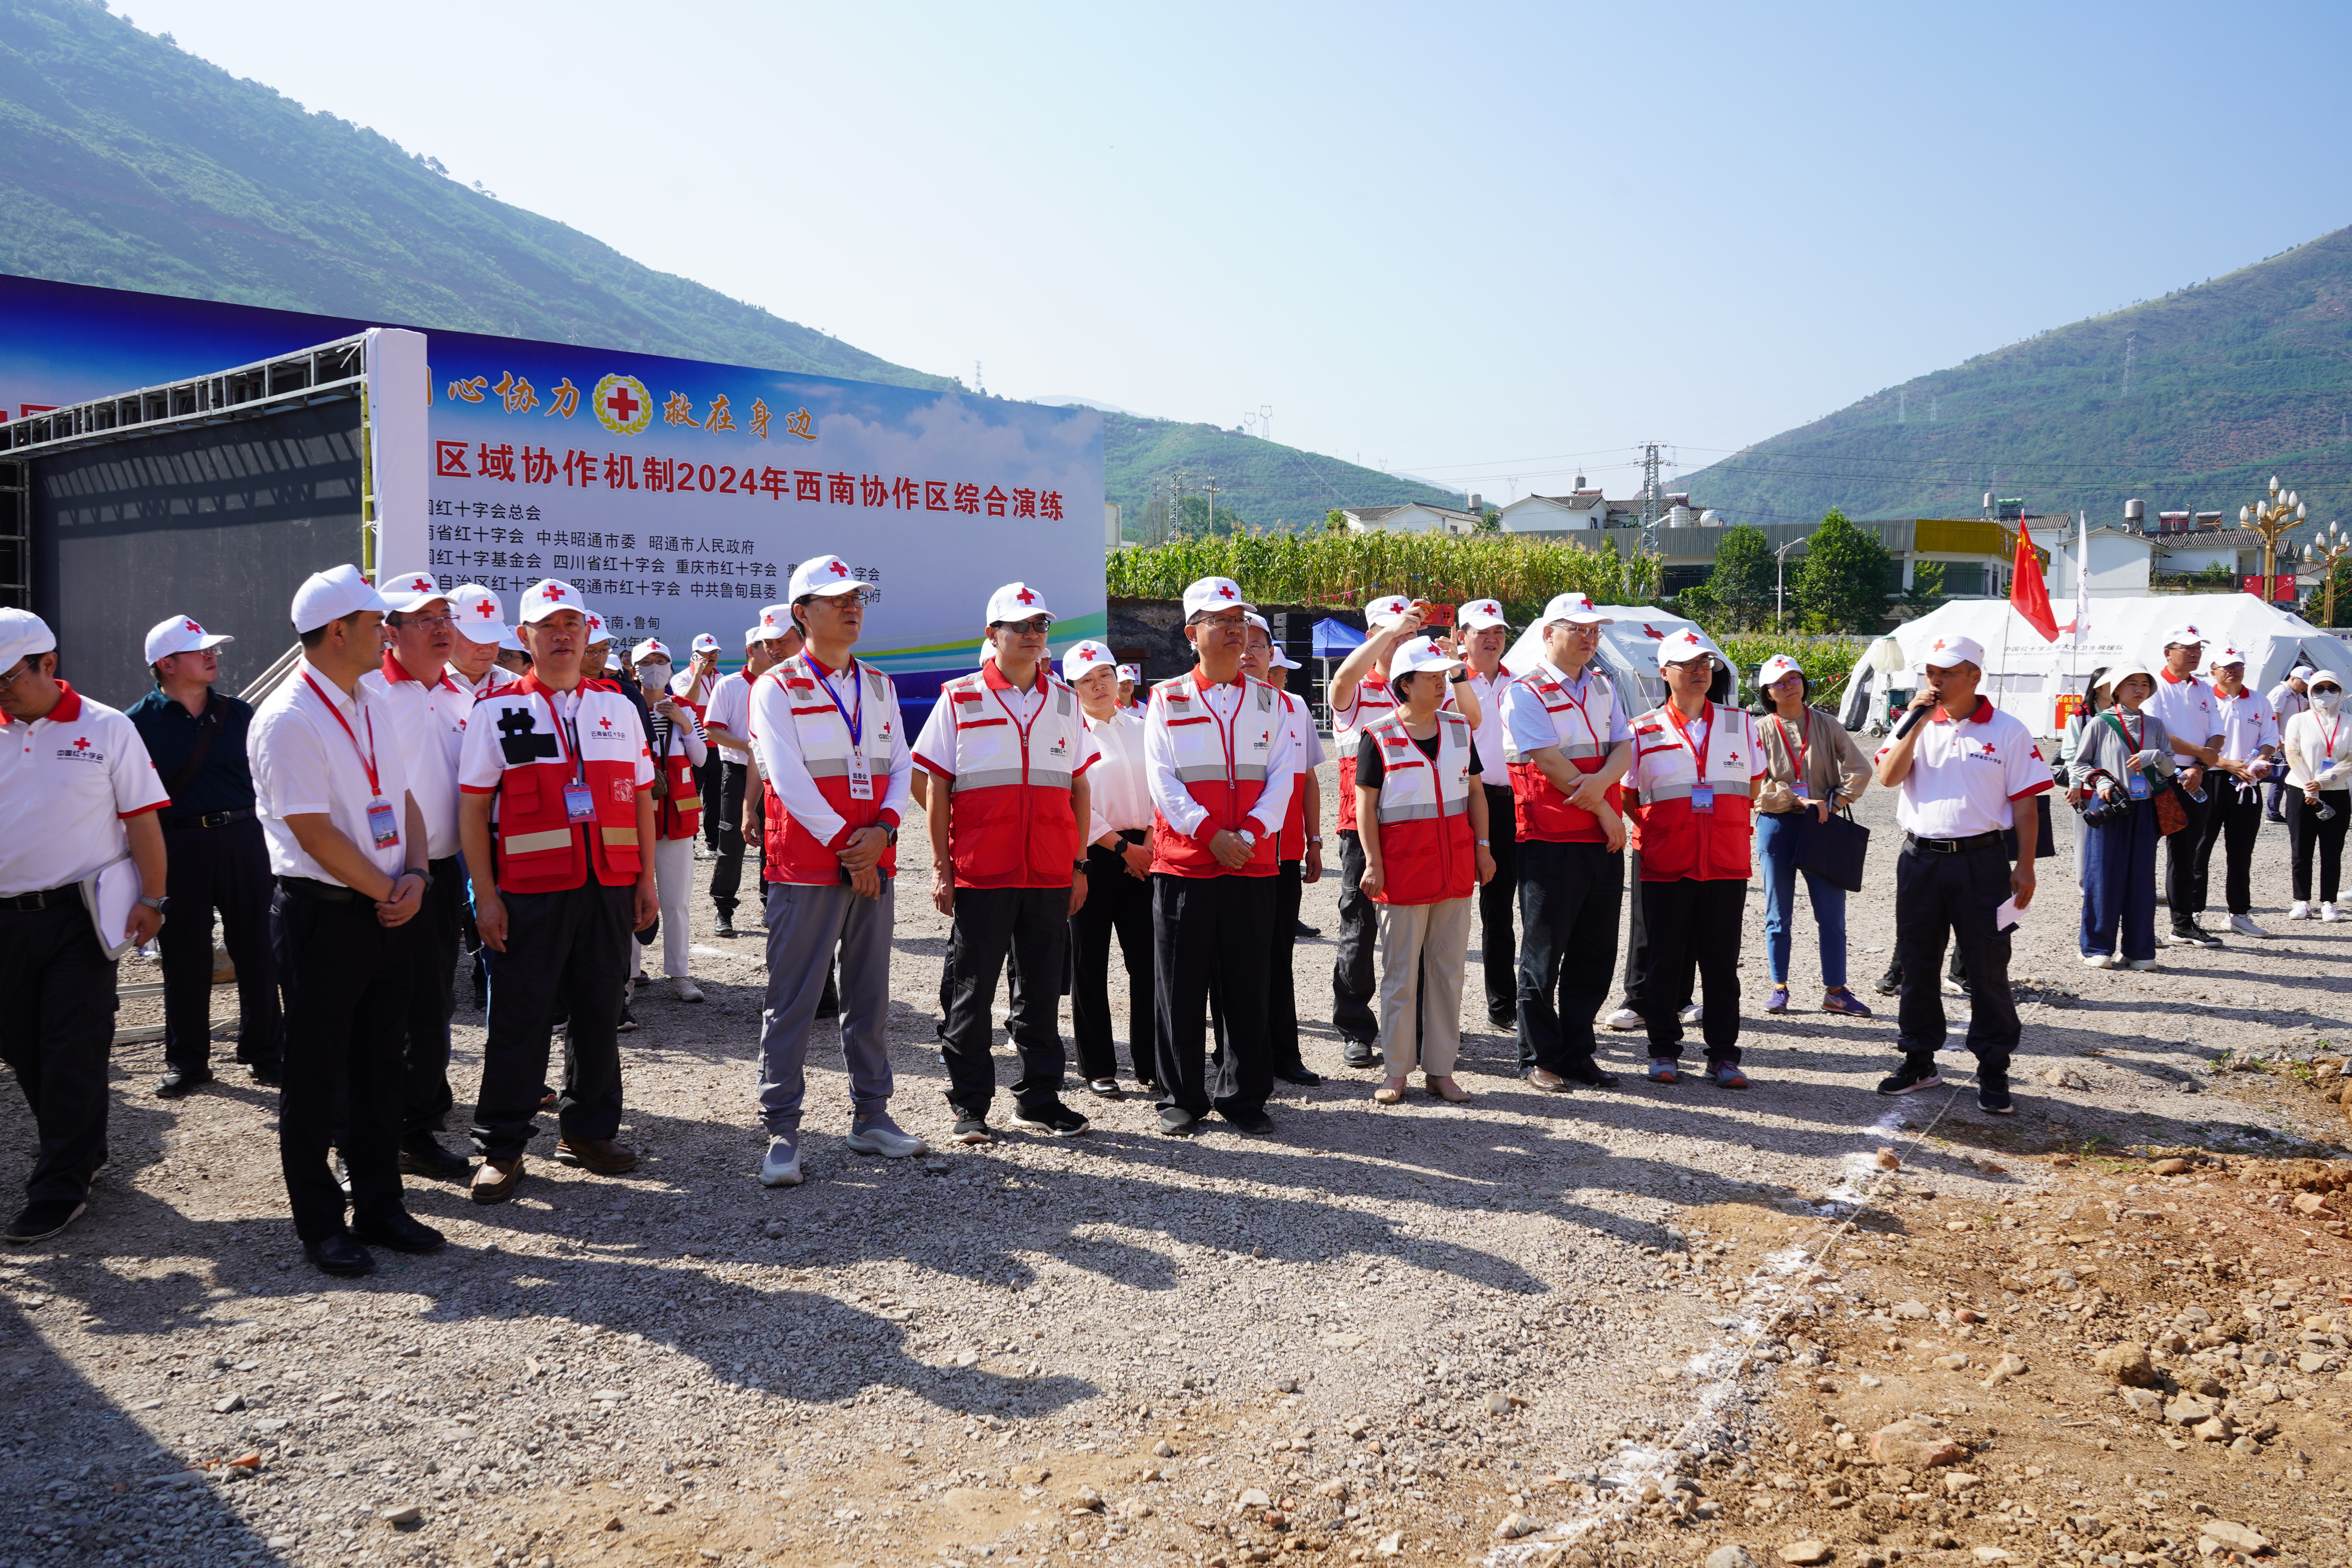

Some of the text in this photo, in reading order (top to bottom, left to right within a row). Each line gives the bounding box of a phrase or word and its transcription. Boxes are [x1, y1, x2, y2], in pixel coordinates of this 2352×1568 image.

[427, 366, 818, 441] 心协力 救在身边
[436, 440, 1064, 521] 区域协作机制2024年西南协作区综合演练
[537, 529, 636, 549] 中共昭通市委
[649, 535, 755, 555] 昭通市人民政府
[554, 554, 665, 573] 四川省红十字会
[676, 558, 777, 577] 重庆市红十字会
[430, 573, 777, 599] 自治区红十字 昭通市红十字会 中共鲁甸县委
